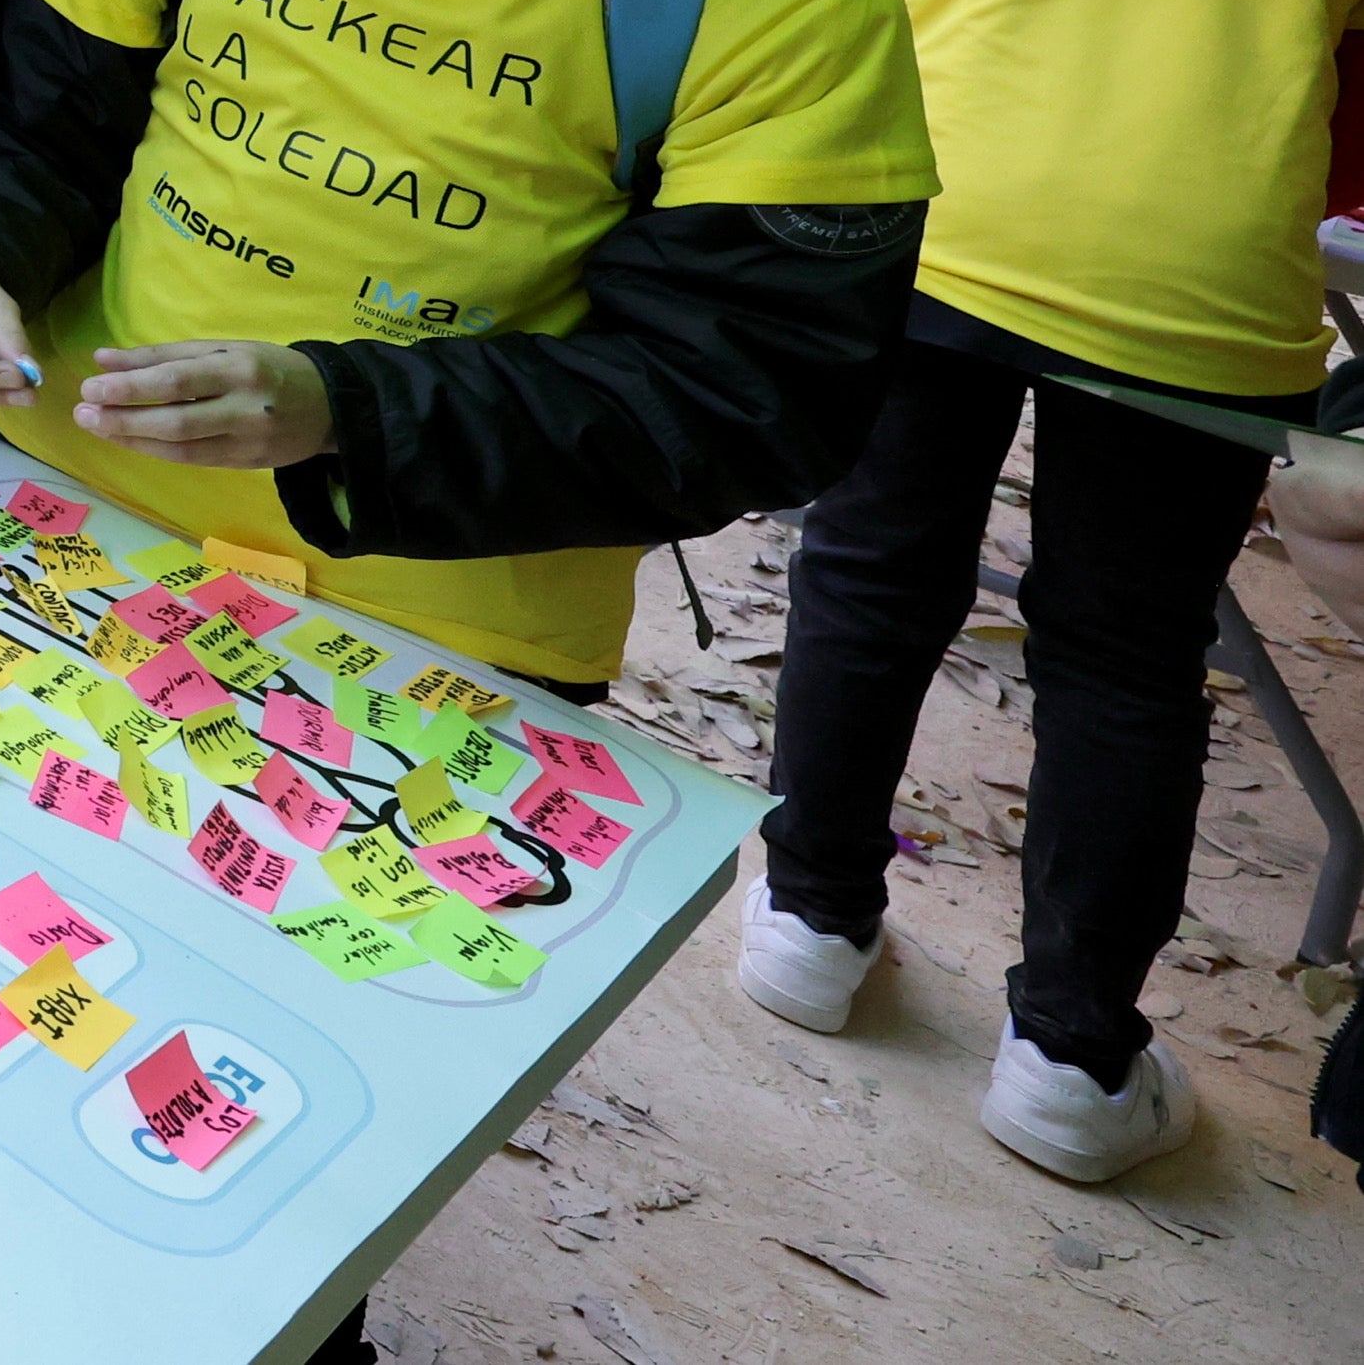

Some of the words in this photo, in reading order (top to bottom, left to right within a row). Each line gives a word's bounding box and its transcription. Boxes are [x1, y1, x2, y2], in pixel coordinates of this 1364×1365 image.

[182, 13, 248, 81] LA
[184, 79, 488, 231] SOLEDAD
[152, 172, 296, 279] innspire
[353, 300, 414, 328] Instituto
[353, 316, 373, 329] de
[375, 325, 420, 344] Acció
[34, 582, 73, 634] CONTAC
[147, 602, 188, 626] DES
[194, 615, 238, 650] persona
[298, 703, 328, 753] DORMIR
[365, 689, 400, 732] Hablar
[187, 715, 246, 754] Saludable
[532, 729, 569, 768] Amor
[443, 731, 493, 785] DEPORTE
[74, 769, 98, 792] tus
[351, 876, 383, 899] los
[380, 855, 414, 884] con
[342, 939, 395, 966] Hablar
[347, 928, 376, 943] con
[25, 983, 93, 1042] XABI
[206, 1103, 250, 1137] LOS
